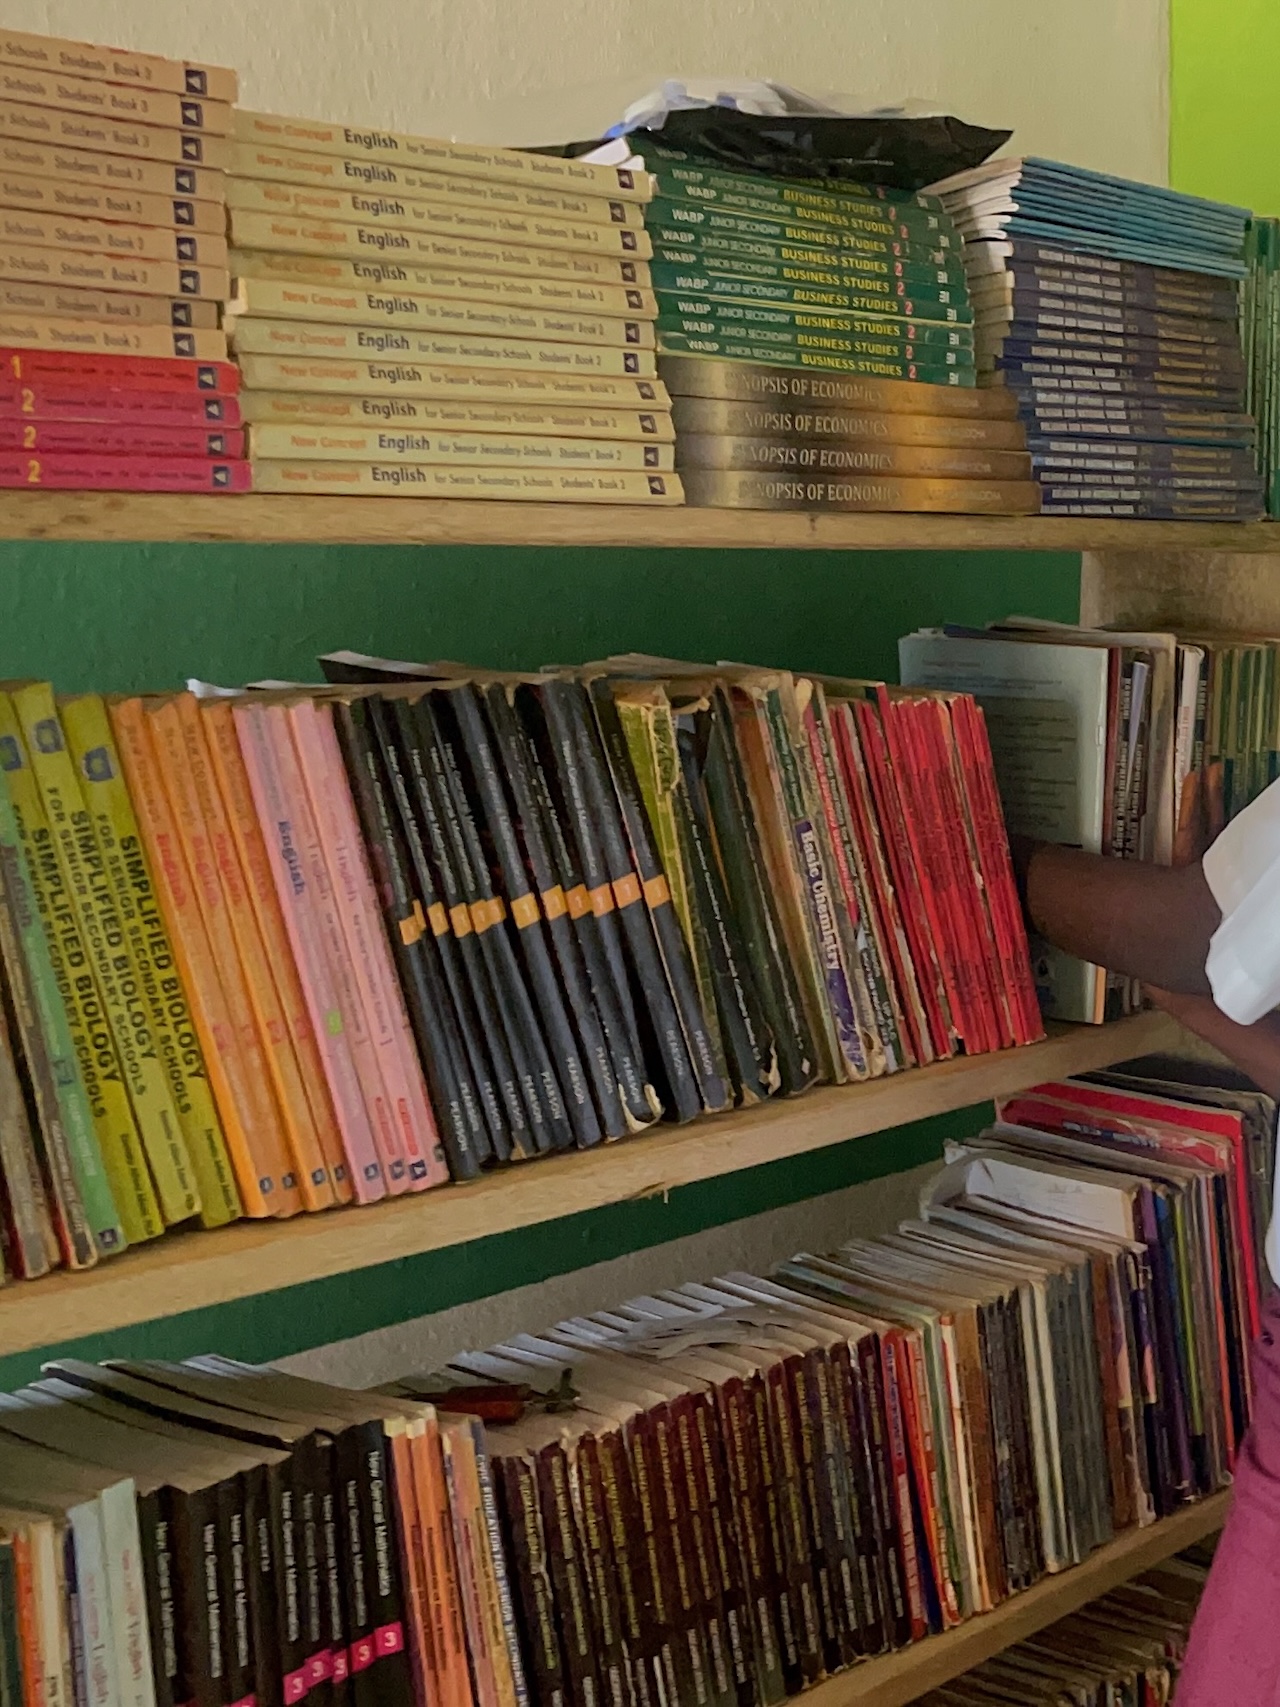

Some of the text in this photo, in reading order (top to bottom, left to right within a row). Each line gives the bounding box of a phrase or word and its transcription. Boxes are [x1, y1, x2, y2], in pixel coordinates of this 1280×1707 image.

[344, 128, 398, 150] English
[344, 162, 398, 183] English
[352, 196, 406, 216] English
[672, 168, 704, 183] WABP
[784, 189, 837, 208] BUSINESS
[840, 199, 884, 218] STUDIES
[685, 185, 717, 200] WABP
[796, 207, 849, 227] BUSINESS
[851, 218, 895, 236] STUDIES
[357, 229, 410, 250] English
[672, 209, 902, 256] WABP BUSINESS STUDIES 2
[353, 263, 408, 283] English
[661, 230, 903, 276] WABP BUSINESS STUDIES 2
[662, 250, 905, 296] WABP BUSINESS STUDIES 2
[367, 295, 418, 315] English
[676, 276, 710, 290] WABP
[794, 289, 850, 306] BUSINESS
[852, 296, 898, 312] STUDIES
[904, 301, 914, 315] 2
[678, 301, 712, 314] WABP
[795, 315, 851, 331] BUSINESS
[854, 321, 900, 336] STUDIES
[907, 325, 916, 339] 2
[682, 320, 716, 334] WABP
[797, 334, 852, 350] BUSINESS
[855, 341, 899, 356] STUDIES
[906, 345, 914, 359] 2
[357, 332, 410, 352] English
[687, 339, 917, 379] WABP BUSINESS STUDIES 2
[12, 355, 21, 378] 1
[368, 365, 422, 384] English
[21, 388, 36, 412] 2
[362, 400, 418, 420] English
[791, 379, 808, 396] OF
[811, 380, 882, 402] ECONOMICS
[24, 425, 36, 448] 2
[378, 434, 430, 453] English
[795, 414, 812, 432] OF
[815, 416, 888, 436] ECONOMICS
[28, 459, 42, 482] 2
[371, 467, 427, 486] English
[800, 449, 817, 466] OF
[819, 449, 893, 470] ECONOMICS
[807, 483, 824, 500] OF
[828, 484, 901, 501] ECONOMICS
[278, 821, 306, 896] English
[801, 831, 822, 878] Basic
[812, 880, 840, 970] Chemistry
[32, 827, 85, 968] SIMPLIFIED
[75, 975, 121, 1082] BIOLOGY
[47, 787, 66, 823] FOR
[59, 829, 88, 895] SENIOR
[81, 902, 120, 1006] SECONDARY
[114, 1013, 147, 1096] SCHOOLS
[71, 811, 158, 1059] SIMPLIFIED BIOLOGY
[97, 814, 115, 849] FOR
[108, 855, 136, 921] SENIOR
[128, 926, 168, 1028] SECONDARY
[160, 1035, 192, 1114] SCHOOLS
[119, 835, 173, 970] SIMPLIFIED
[161, 977, 206, 1078] BIOLOGY
[666, 1029, 683, 1076] PEARSON
[695, 1030, 713, 1076] PEARSON
[74, 1035, 107, 1118] SCHOOLS
[541, 1071, 562, 1120] PEARSON
[566, 1056, 584, 1104] PEARSON
[623, 1056, 641, 1104] PEARSON
[505, 1081, 525, 1130] PEARSON
[524, 1074, 543, 1124] PEARSON
[450, 1101, 468, 1152] PEARSON
[368, 1451, 381, 1478] New
[476, 1454, 490, 1482] CIVIC
[370, 1479, 386, 1524] General
[482, 1486, 502, 1552] EDUCATION
[374, 1525, 392, 1597] Mathematics
[493, 1553, 506, 1576] FOR
[498, 1581, 513, 1622] SENIOR
[505, 1624, 526, 1691] SECONDARY
